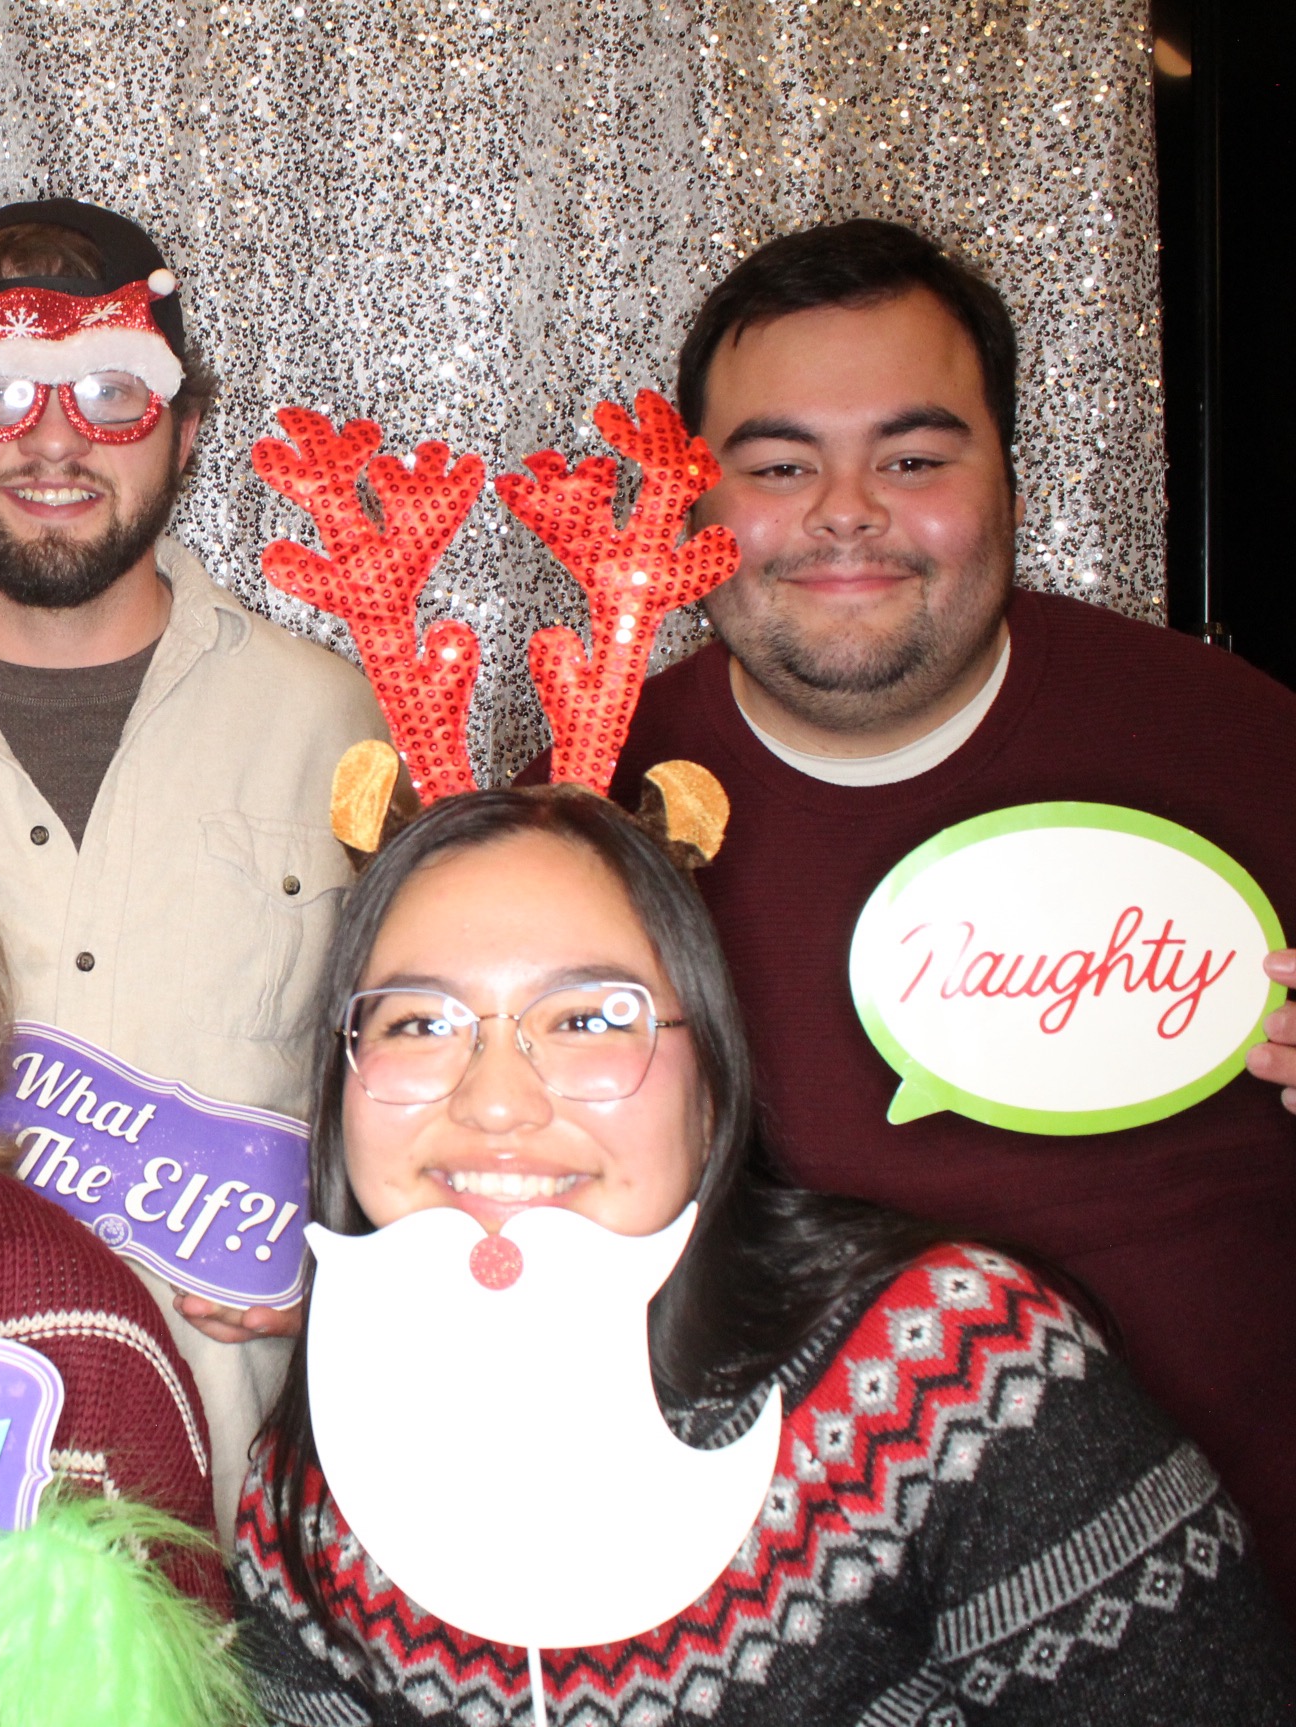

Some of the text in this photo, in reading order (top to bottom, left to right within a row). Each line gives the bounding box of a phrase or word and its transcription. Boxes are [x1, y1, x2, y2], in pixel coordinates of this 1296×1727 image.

[900, 906, 1237, 1040] Naughty
[12, 1052, 157, 1143] What
[15, 1126, 299, 1262] The Elf?!
